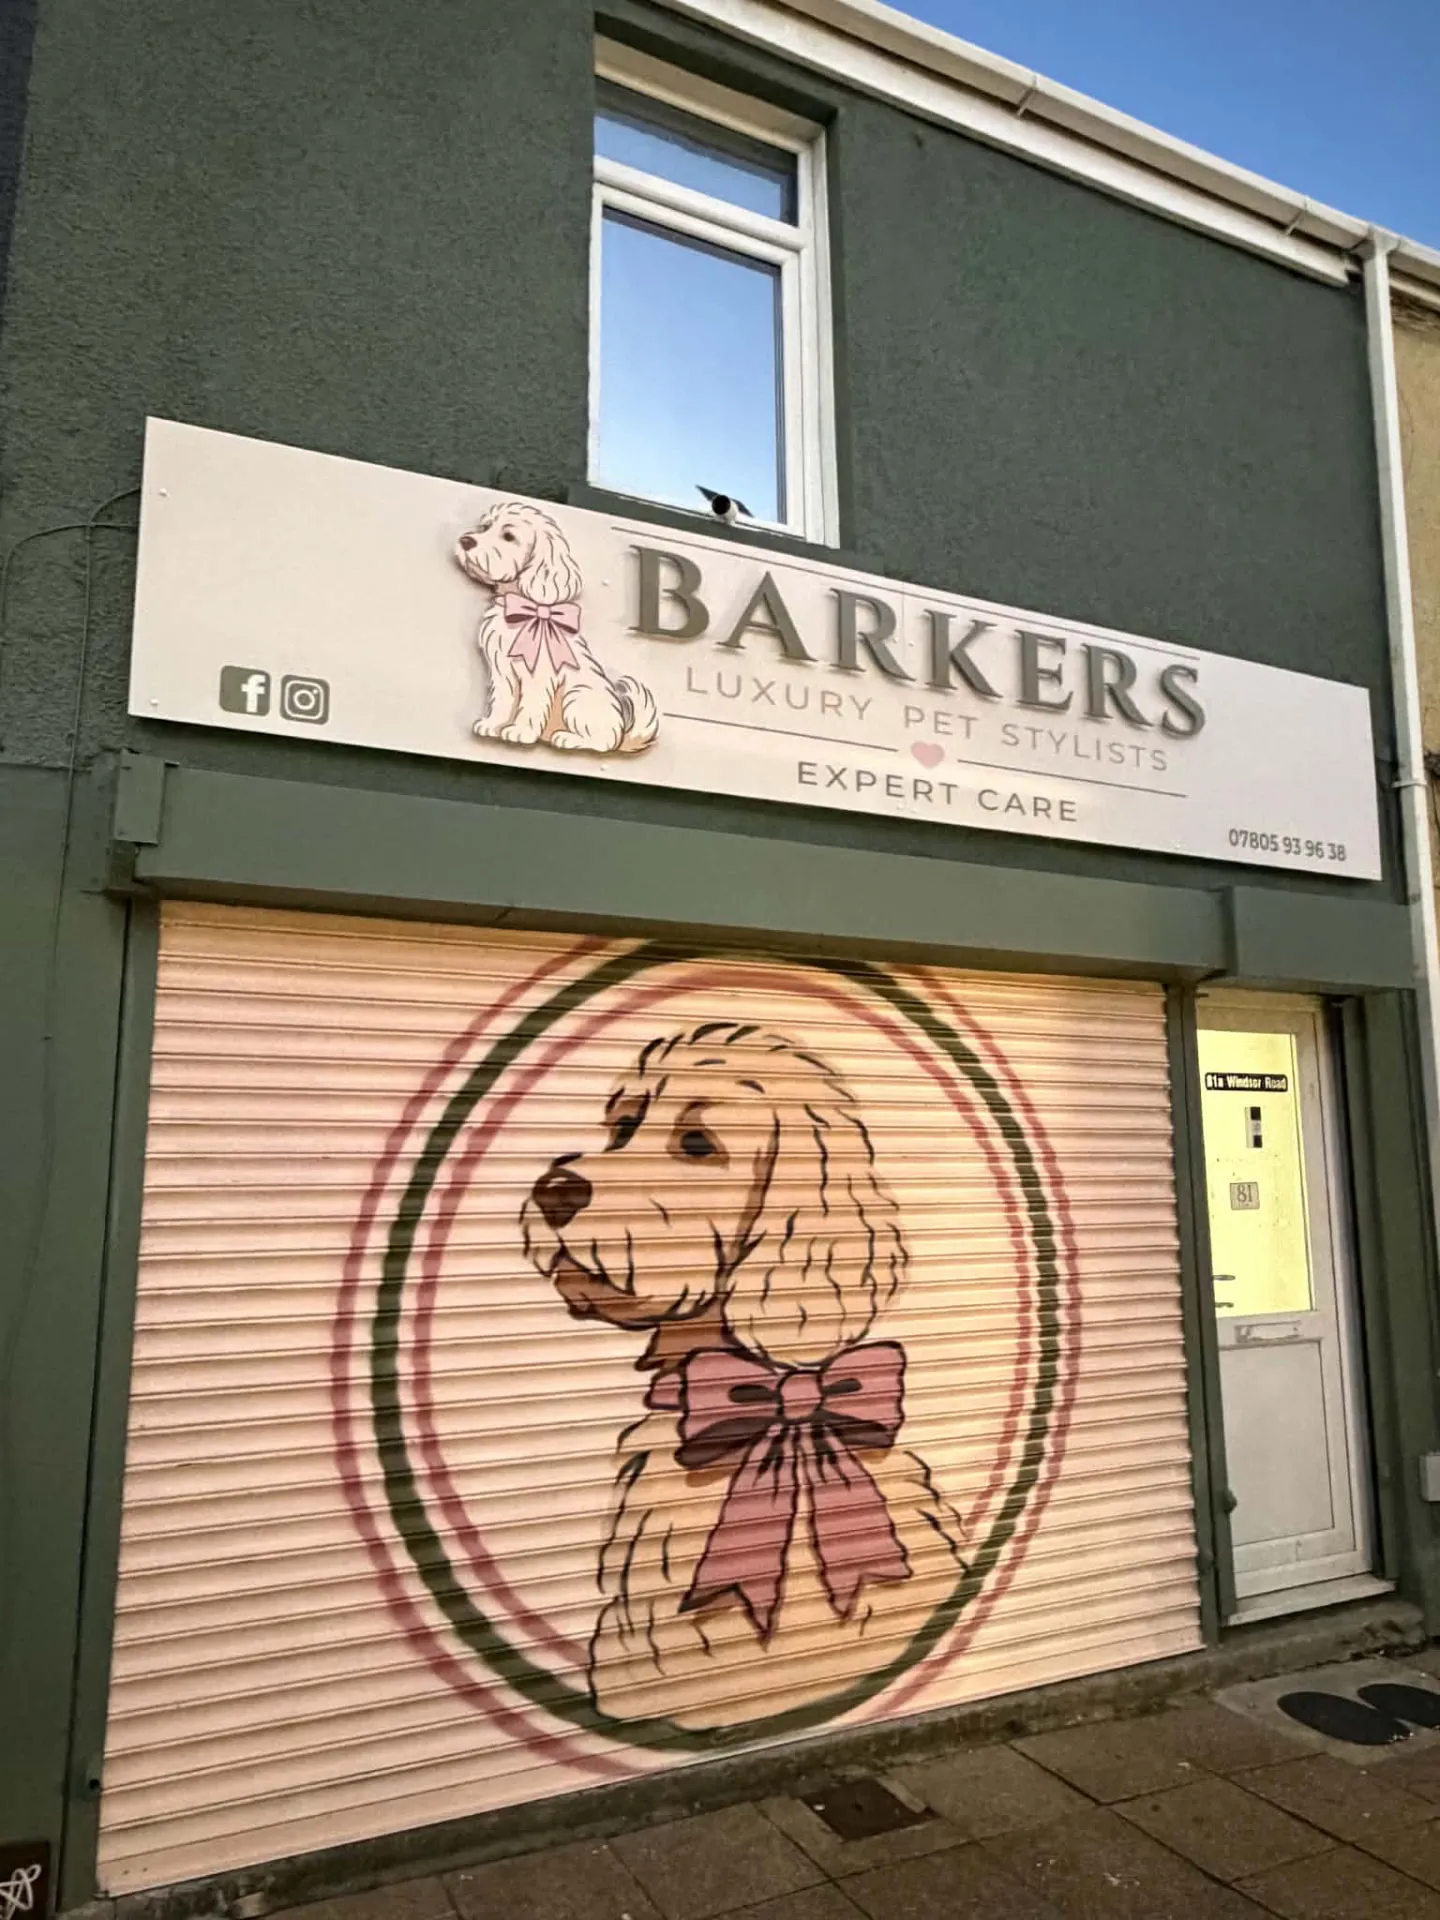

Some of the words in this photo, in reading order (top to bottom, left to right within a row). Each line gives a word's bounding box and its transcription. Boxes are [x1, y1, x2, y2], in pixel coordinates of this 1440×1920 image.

[629, 544, 1208, 740] BARKERS
[686, 666, 873, 721] LUXURY
[904, 704, 979, 740] PET
[1000, 722, 1169, 772] STYLISTS
[798, 760, 958, 806] EXPERT
[977, 788, 1078, 822] CARE
[1228, 828, 1279, 852] 07805
[1282, 836, 1301, 856] 93
[1304, 840, 1325, 859] 96
[1327, 843, 1346, 862] 38
[1226, 1075, 1262, 1089] Windsor
[1264, 1076, 1287, 1090] Road
[1236, 1183, 1253, 1203] 81
